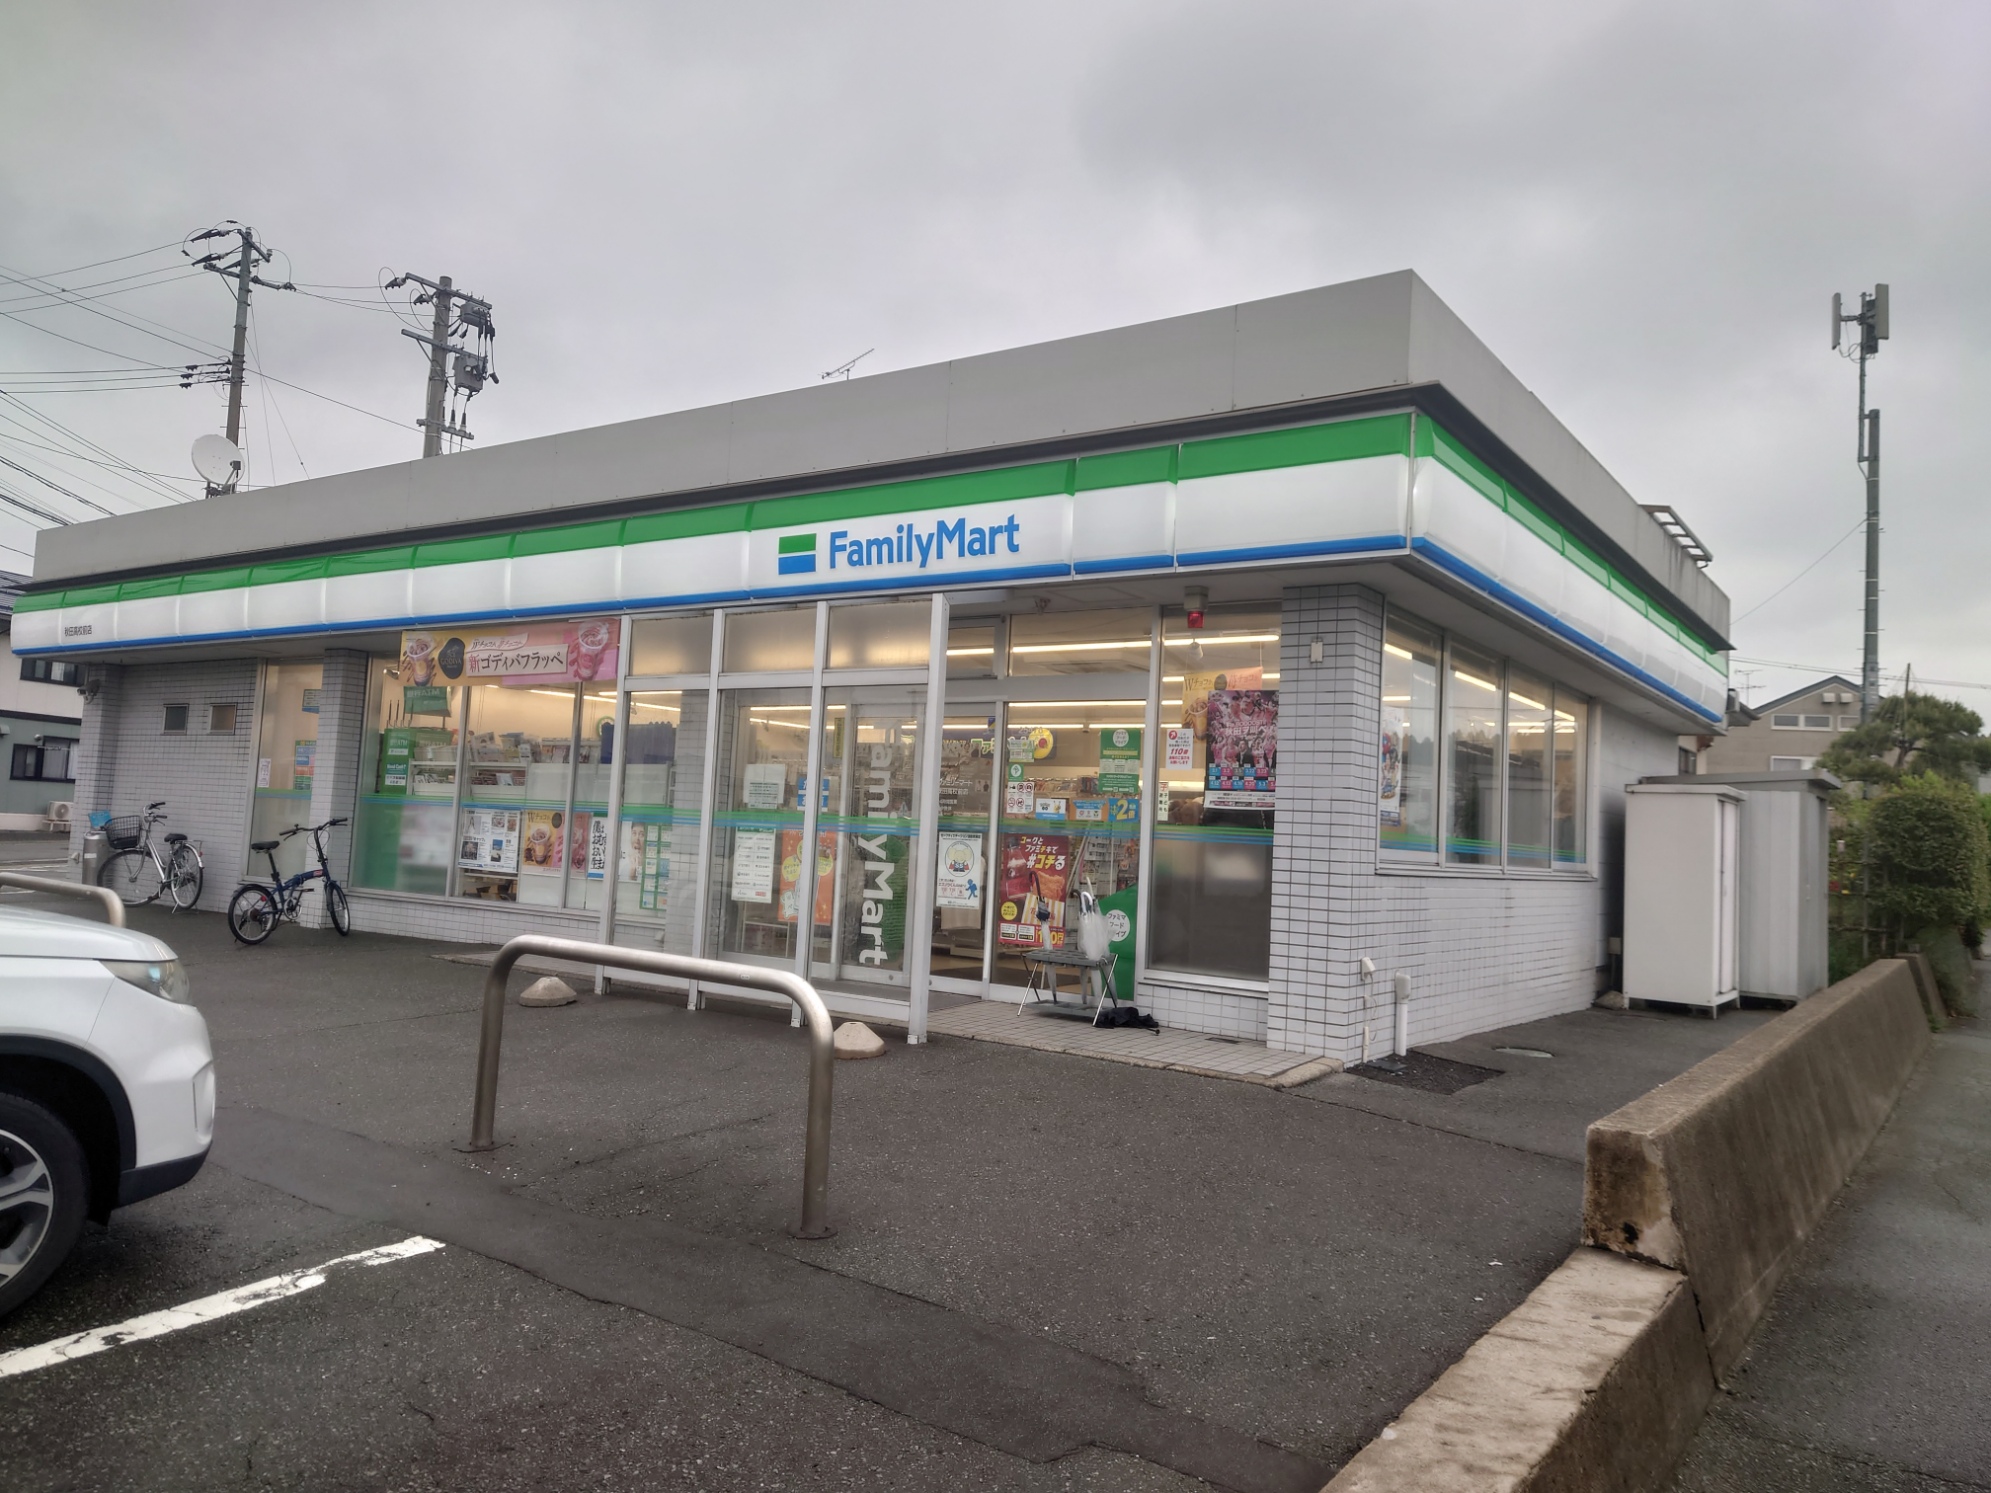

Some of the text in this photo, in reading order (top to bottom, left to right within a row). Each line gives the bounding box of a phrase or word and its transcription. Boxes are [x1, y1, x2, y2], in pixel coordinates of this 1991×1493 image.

[829, 514, 1020, 569] FamilyMart
[469, 652, 563, 673] 新ゴディバフラッペ
[1020, 836, 1044, 845] コークと
[1025, 844, 1059, 854] ファミチキで
[1026, 853, 1066, 871] #コチる
[1109, 921, 1125, 929] フード
